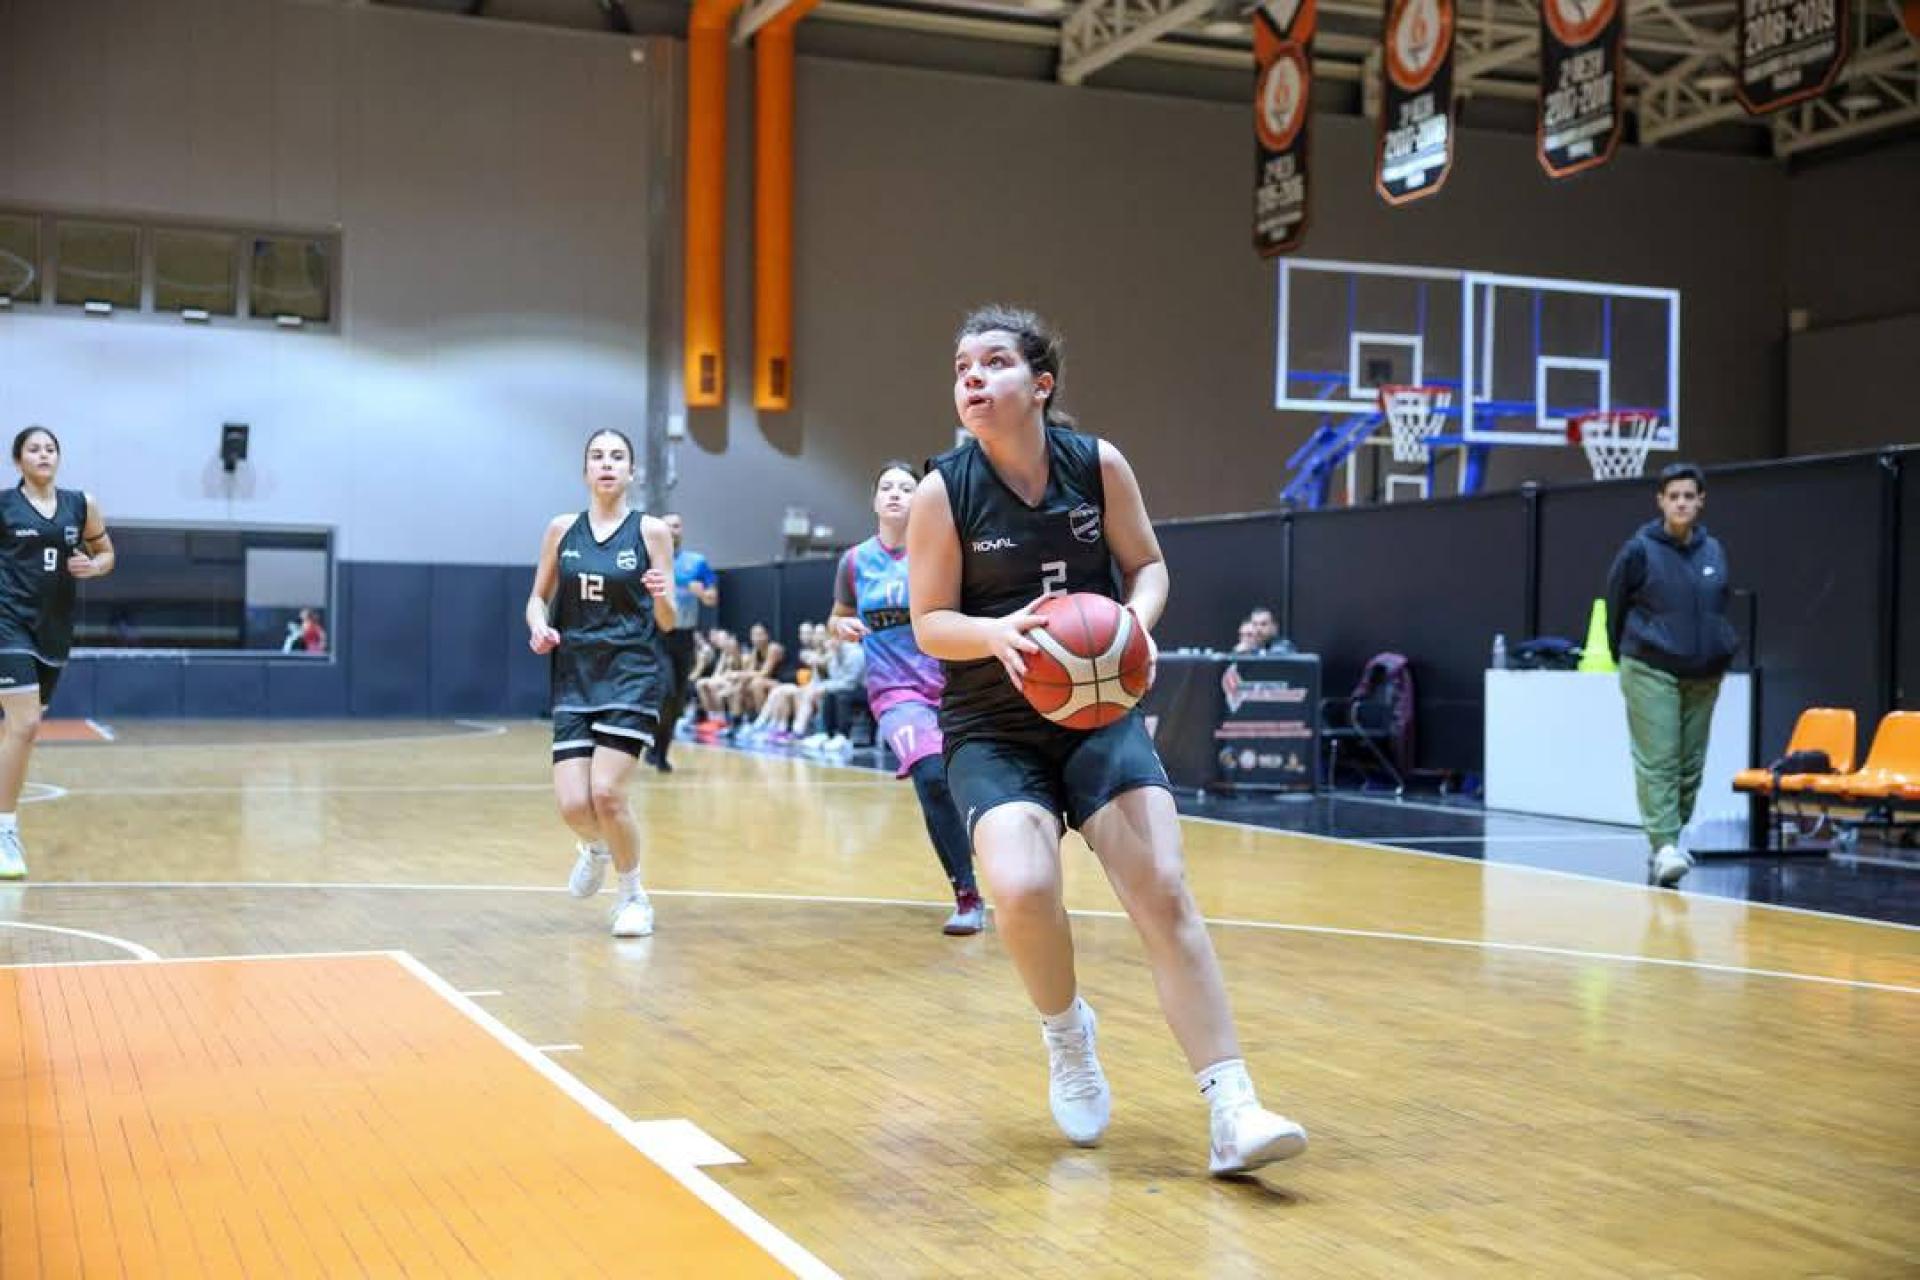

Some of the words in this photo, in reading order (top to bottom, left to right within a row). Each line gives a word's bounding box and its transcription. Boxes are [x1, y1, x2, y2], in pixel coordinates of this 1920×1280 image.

[43, 547, 58, 572] 9
[972, 537, 1019, 552] ROYAL
[577, 572, 605, 602] 12
[1041, 560, 1068, 597] 2
[893, 724, 915, 757] 17
